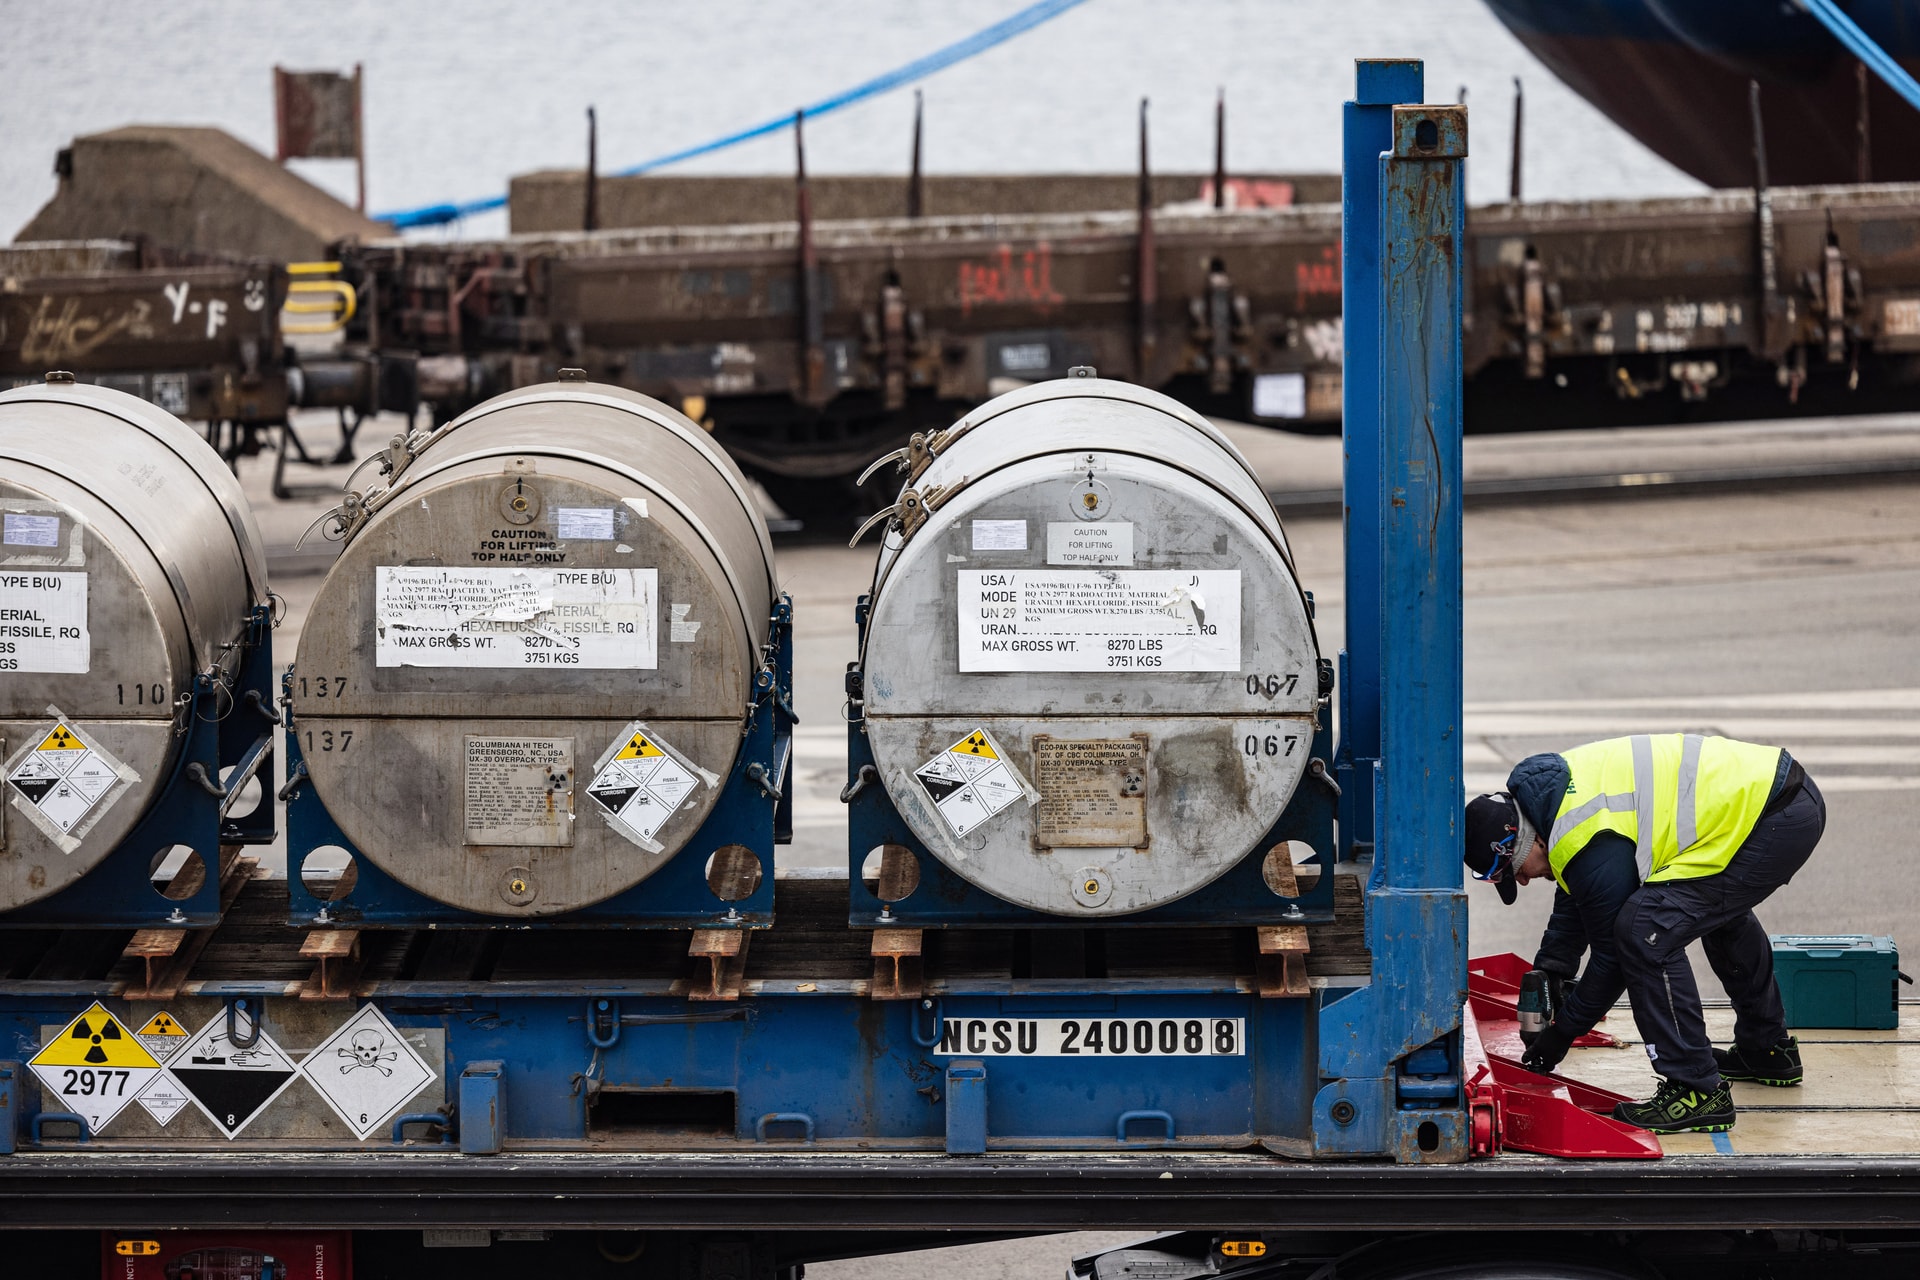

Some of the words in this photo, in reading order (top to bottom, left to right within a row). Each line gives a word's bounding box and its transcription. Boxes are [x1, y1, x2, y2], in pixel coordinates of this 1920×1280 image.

[492, 530, 546, 539] CAUTION
[481, 542, 505, 550] FOR
[472, 553, 495, 561] TOP
[500, 553, 531, 562] HALF
[535, 553, 566, 562] ONLY
[0, 577, 28, 587] YPE
[32, 577, 61, 591] B(U)
[557, 573, 588, 584] TYPE
[592, 574, 616, 585] B(U)
[981, 575, 1006, 586] USA
[981, 592, 1016, 602] MODE
[0, 610, 45, 623] ERIAL,
[981, 608, 999, 618] UN
[1003, 608, 1016, 618] 29
[0, 627, 55, 639] FISSILE,
[59, 628, 80, 639] RQ
[564, 623, 613, 634] FISSILE,
[618, 623, 634, 634] RQ
[1200, 625, 1217, 635] RQ
[0, 643, 15, 653] BS
[399, 637, 425, 647] MAX
[474, 638, 496, 648] WT.
[525, 637, 552, 648] 8270
[982, 641, 1008, 651] MAX
[1011, 641, 1053, 651] GROSS
[1057, 641, 1079, 652] WT.
[1108, 640, 1135, 650] 8270
[1138, 640, 1163, 650] LBS
[525, 653, 550, 663] 3751
[554, 653, 579, 663] KGS
[1108, 656, 1132, 666] 3751
[1136, 656, 1162, 666] KGS
[0, 659, 18, 669] GS
[300, 676, 347, 698] 137
[1246, 674, 1299, 696] 067
[117, 683, 165, 705] 110
[305, 730, 353, 752] 137
[1245, 735, 1298, 757] 067
[926, 776, 953, 787] CORROSIVE
[940, 1020, 1038, 1054] NCSU
[1060, 1020, 1203, 1054] 240008
[1214, 1020, 1235, 1054] 8
[62, 1069, 130, 1096] 2977
[92, 1115, 99, 1126] 7
[227, 1114, 235, 1126] 8
[360, 1113, 368, 1124] 6
[315, 1244, 324, 1280] EXTINCT
